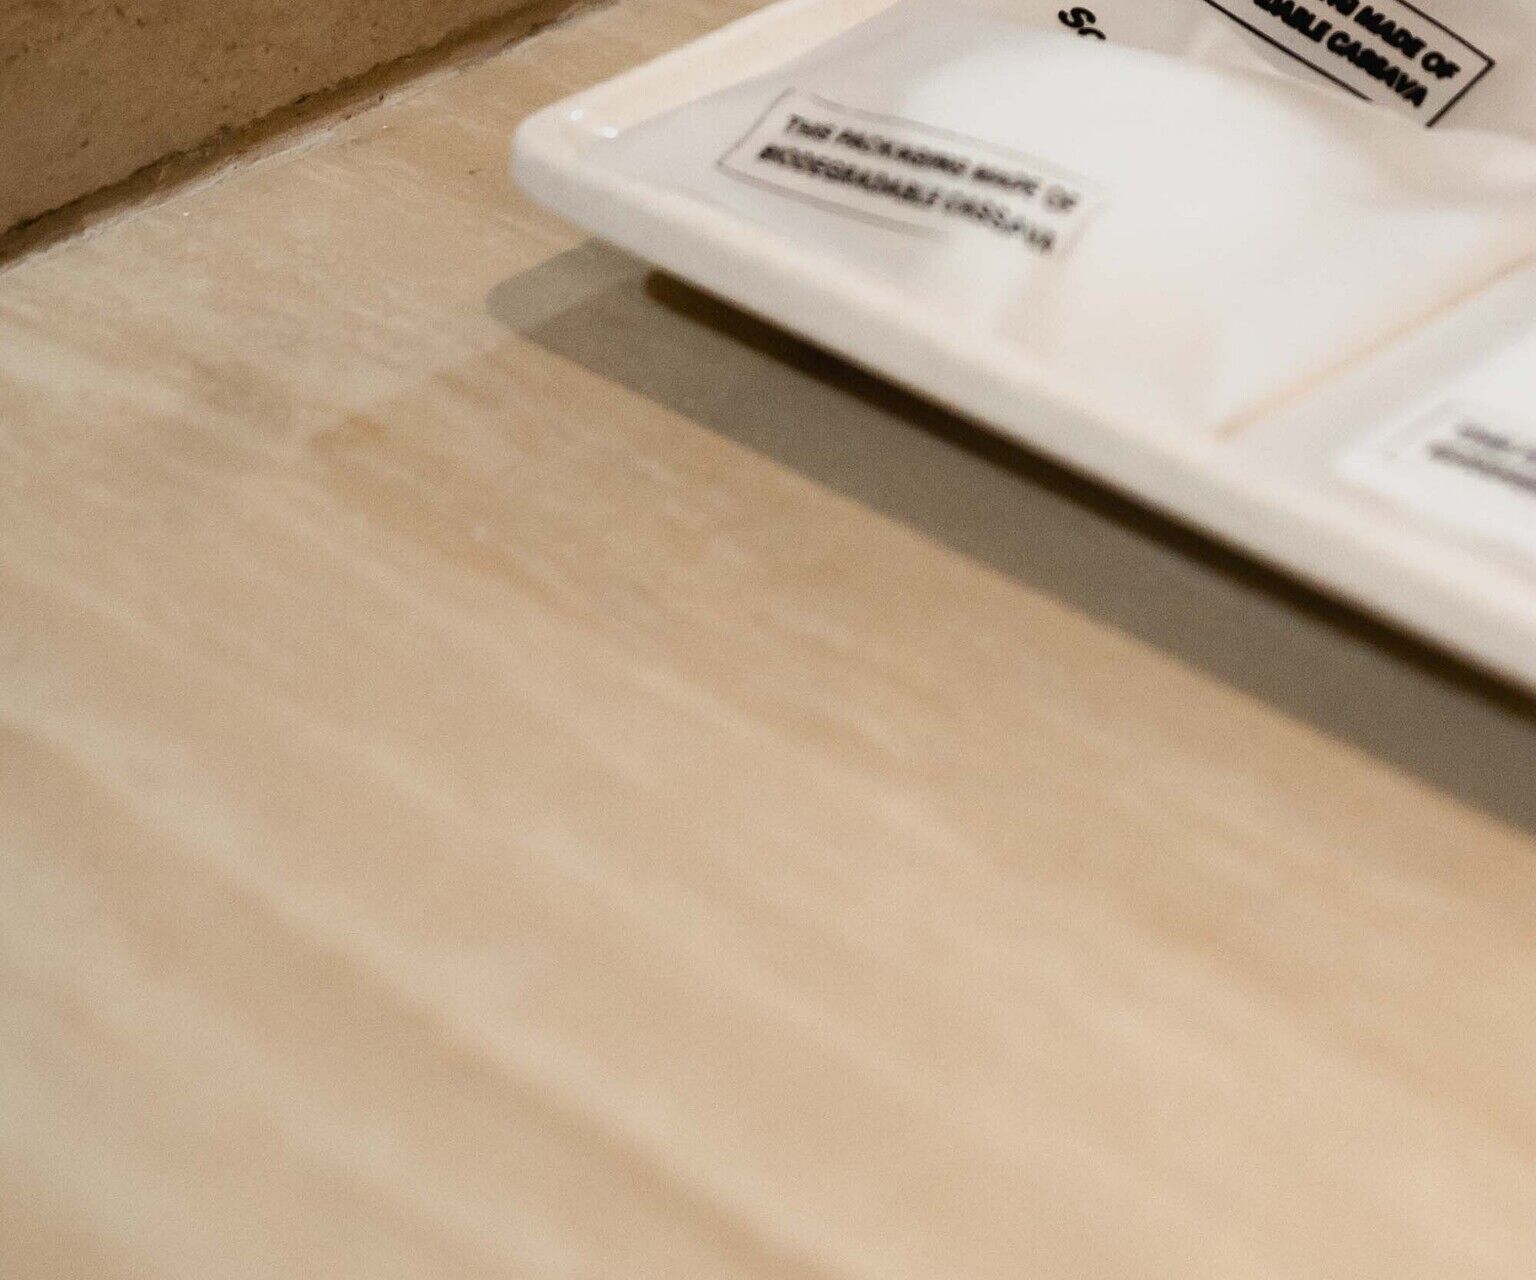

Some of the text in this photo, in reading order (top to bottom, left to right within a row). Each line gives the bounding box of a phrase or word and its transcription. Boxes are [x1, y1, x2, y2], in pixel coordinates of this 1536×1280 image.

[1326, 30, 1429, 109] CASSAVA
[1353, 4, 1428, 59] MADE
[1421, 51, 1461, 80] OF
